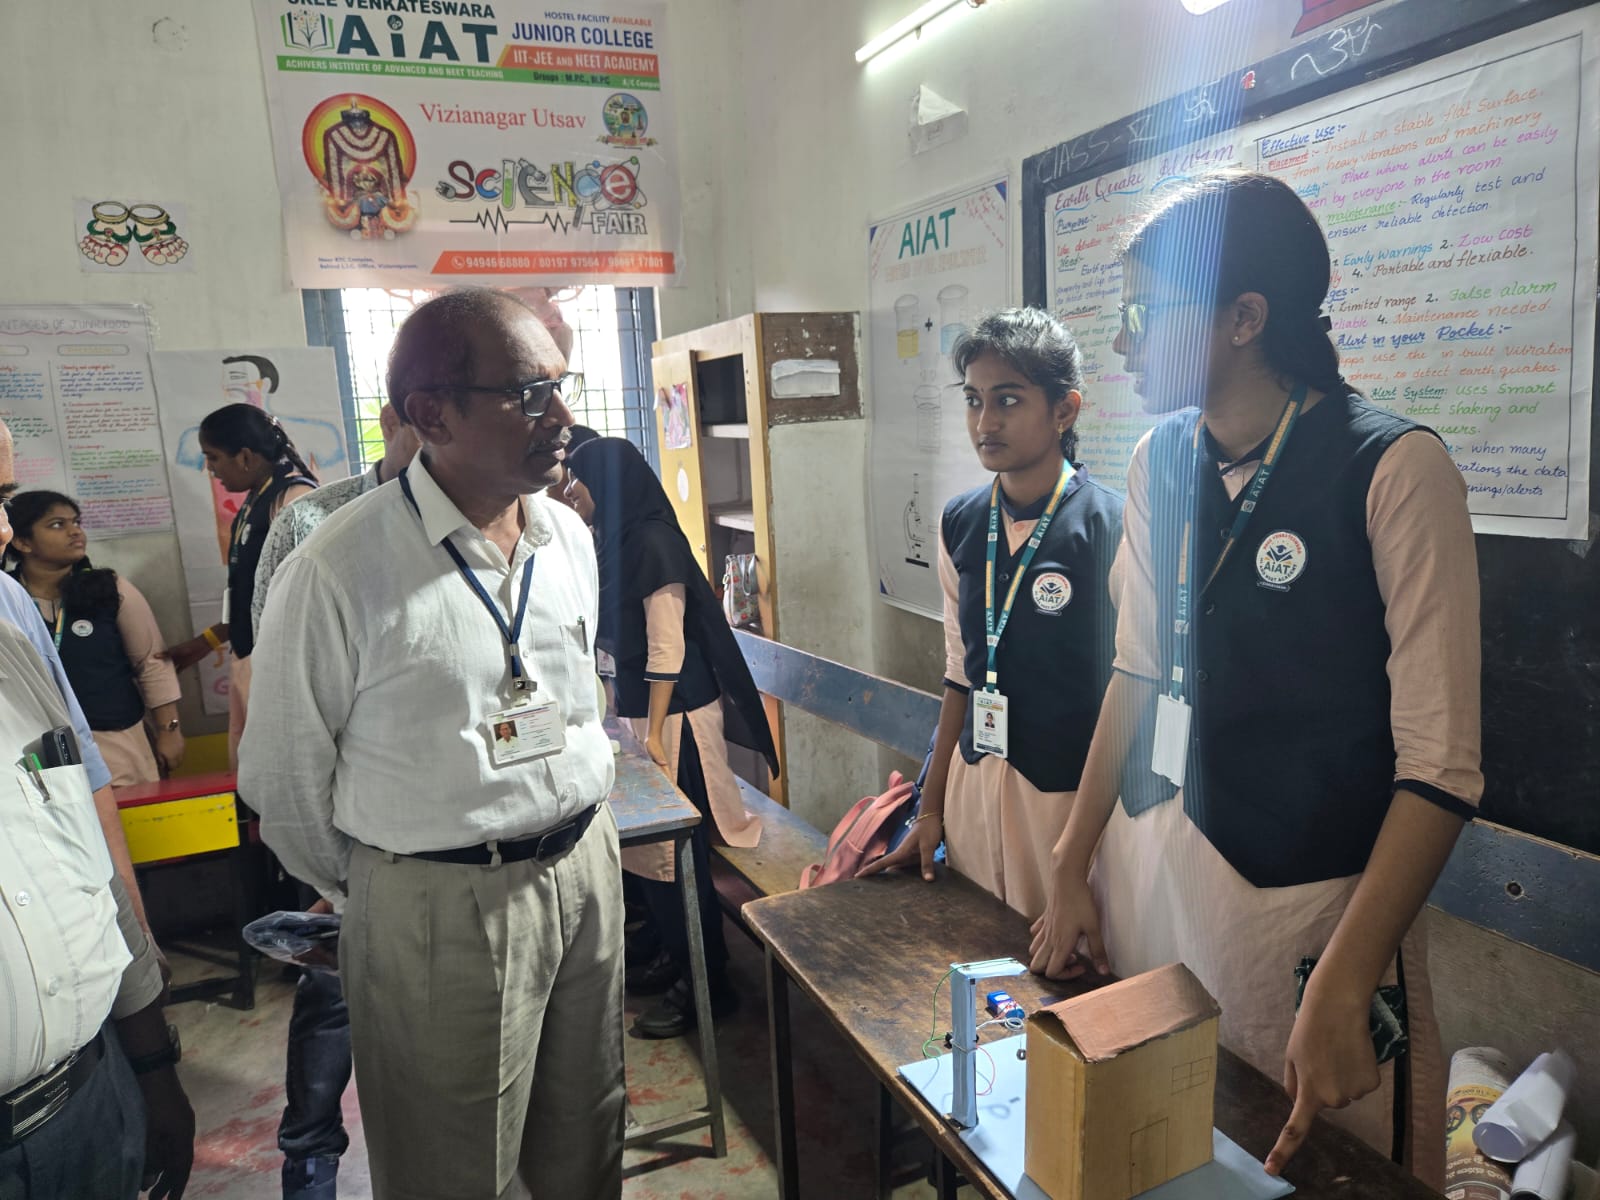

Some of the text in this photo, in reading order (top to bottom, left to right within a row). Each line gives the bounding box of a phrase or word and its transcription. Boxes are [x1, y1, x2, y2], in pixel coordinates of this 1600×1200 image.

[345, 0, 495, 18] VENKATESWARA
[544, 12, 652, 26] HOSTEL FACILITY AVAILABLE
[512, 22, 654, 49] JUNIOR COLLEGE
[285, 59, 504, 79] ACHIVERS INSTITUTE OF ADVANCED AND NEET TEACHING
[513, 49, 656, 71] IIT-JEE AND NEET ACADEMY
[420, 103, 587, 130] Vizianagar Utsav
[1324, 129, 1368, 154] Install
[1373, 128, 1388, 140] on
[1394, 112, 1435, 135] stable
[1443, 100, 1471, 122] flat
[1262, 132, 1311, 156] Effective
[1326, 158, 1358, 172] heavy
[1425, 128, 1450, 146] and
[1462, 142, 1487, 155] can
[1493, 135, 1508, 148] be
[1517, 124, 1559, 145] easily
[1333, 191, 1347, 208] by
[1353, 179, 1407, 202] everyone
[1414, 175, 1427, 186] in
[1431, 169, 1451, 184] the
[1410, 185, 1465, 208] Regularly
[1475, 175, 1503, 193] test
[1511, 167, 1547, 186] and
[590, 212, 648, 235] FAIR
[898, 207, 957, 260] AIAT
[1327, 223, 1368, 240] ensure
[1375, 213, 1422, 230] reliable
[1343, 250, 1374, 271] Early
[1427, 252, 1455, 269] and
[1339, 296, 1380, 313] Limited
[1385, 296, 1417, 311] range
[1450, 286, 1493, 302] False
[1500, 281, 1558, 298] alarm
[1372, 336, 1385, 346] in
[1390, 331, 1425, 349] your
[1373, 352, 1398, 362] use
[1406, 350, 1426, 360] the
[1441, 349, 1454, 358] in
[1412, 365, 1451, 378] detect
[1405, 403, 1441, 415] detect
[1508, 401, 1541, 415] and
[1510, 445, 1548, 462] many
[1506, 465, 1529, 477] the
[1534, 465, 1569, 478] data
